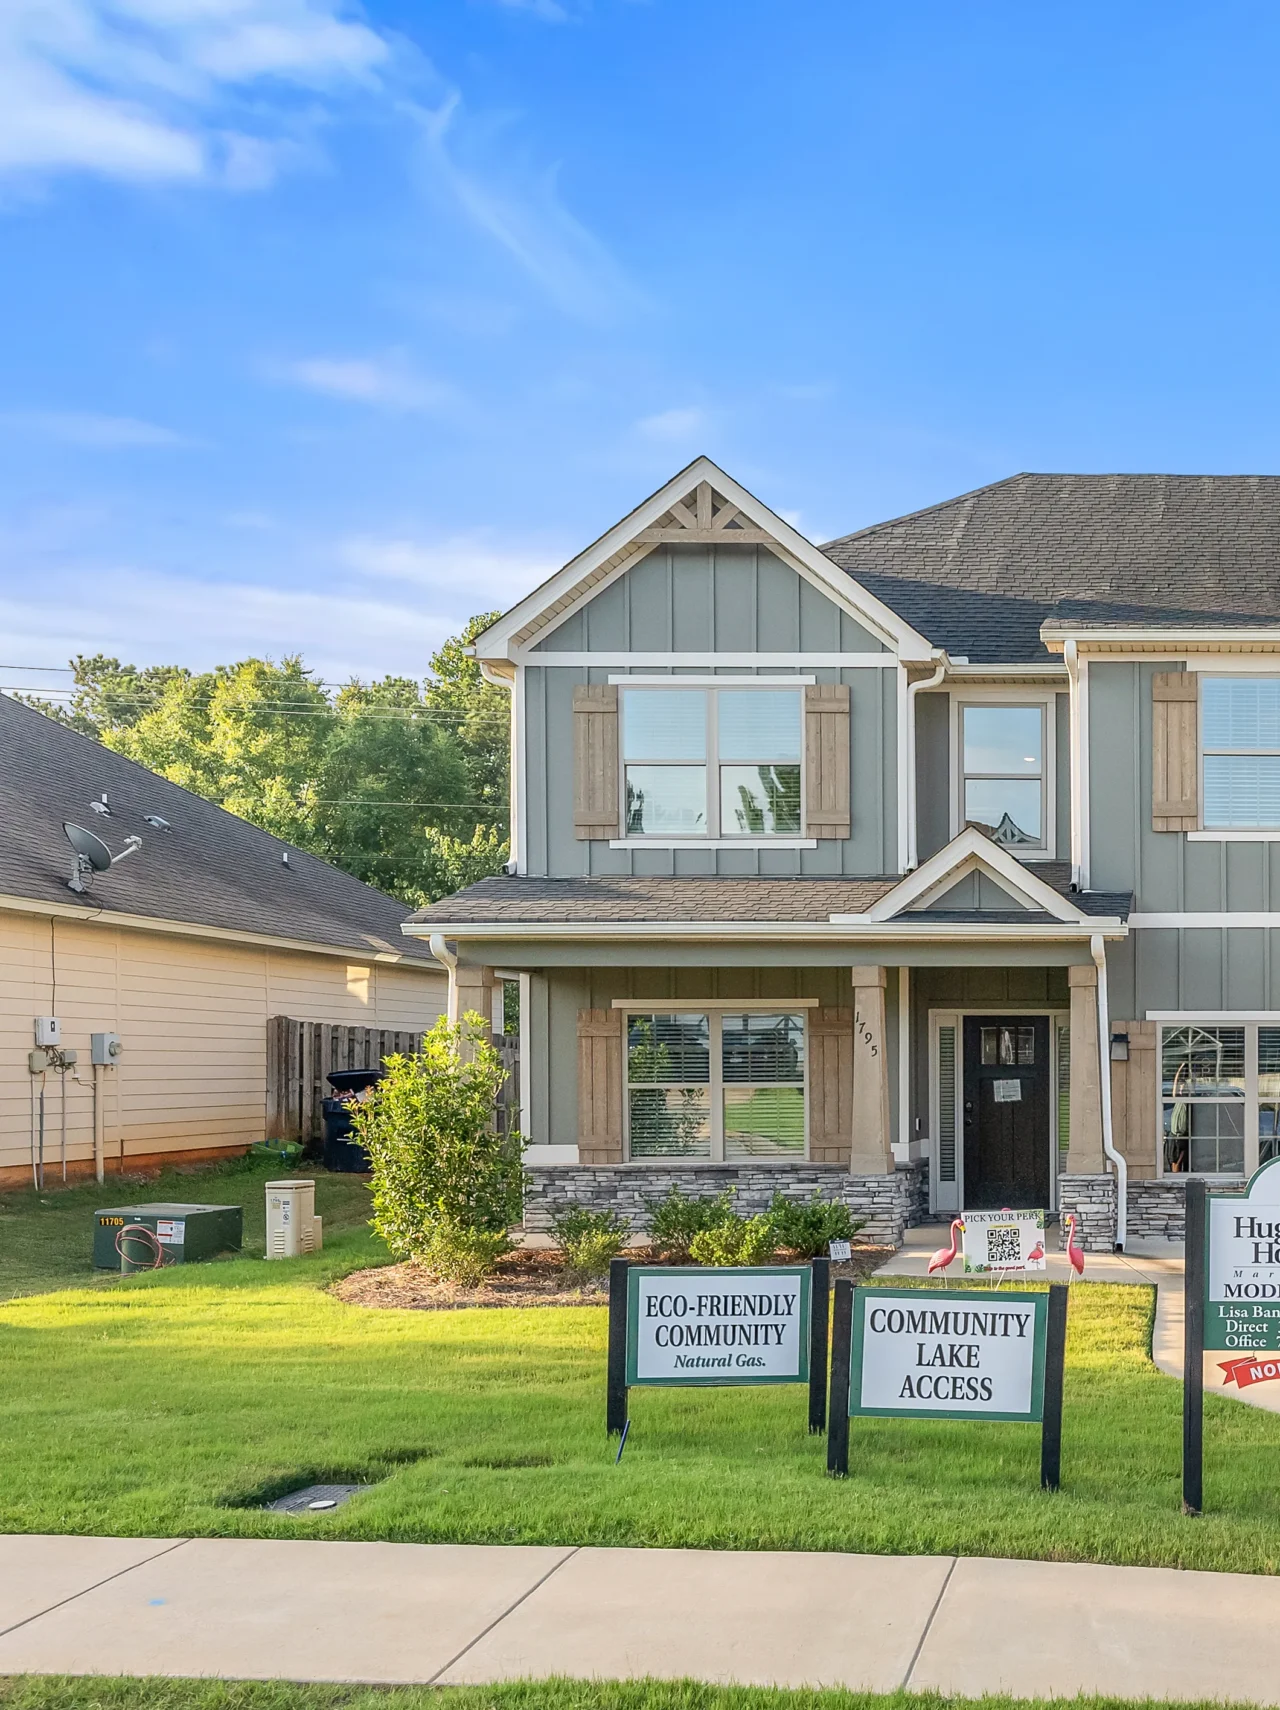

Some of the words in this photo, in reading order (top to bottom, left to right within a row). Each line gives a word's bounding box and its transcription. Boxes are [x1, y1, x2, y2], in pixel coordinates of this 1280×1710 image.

[856, 1011, 878, 1057] 1795
[100, 1217, 124, 1226] 11705
[964, 1214, 987, 1223] PICK
[988, 1213, 1015, 1222] YOUR
[1016, 1212, 1042, 1221] PERK
[645, 1293, 798, 1319] ECO-FRIENDLY
[1218, 1305, 1249, 1319] Lisa
[870, 1308, 1031, 1339] COMMUNITY
[1226, 1319, 1268, 1334] Direct
[655, 1323, 787, 1348] COMMUNITY
[1225, 1334, 1267, 1348] Office
[673, 1353, 732, 1369] Natural
[736, 1353, 767, 1369] Gas.
[915, 1342, 981, 1369] LAKE
[899, 1374, 993, 1402] ACCESS
